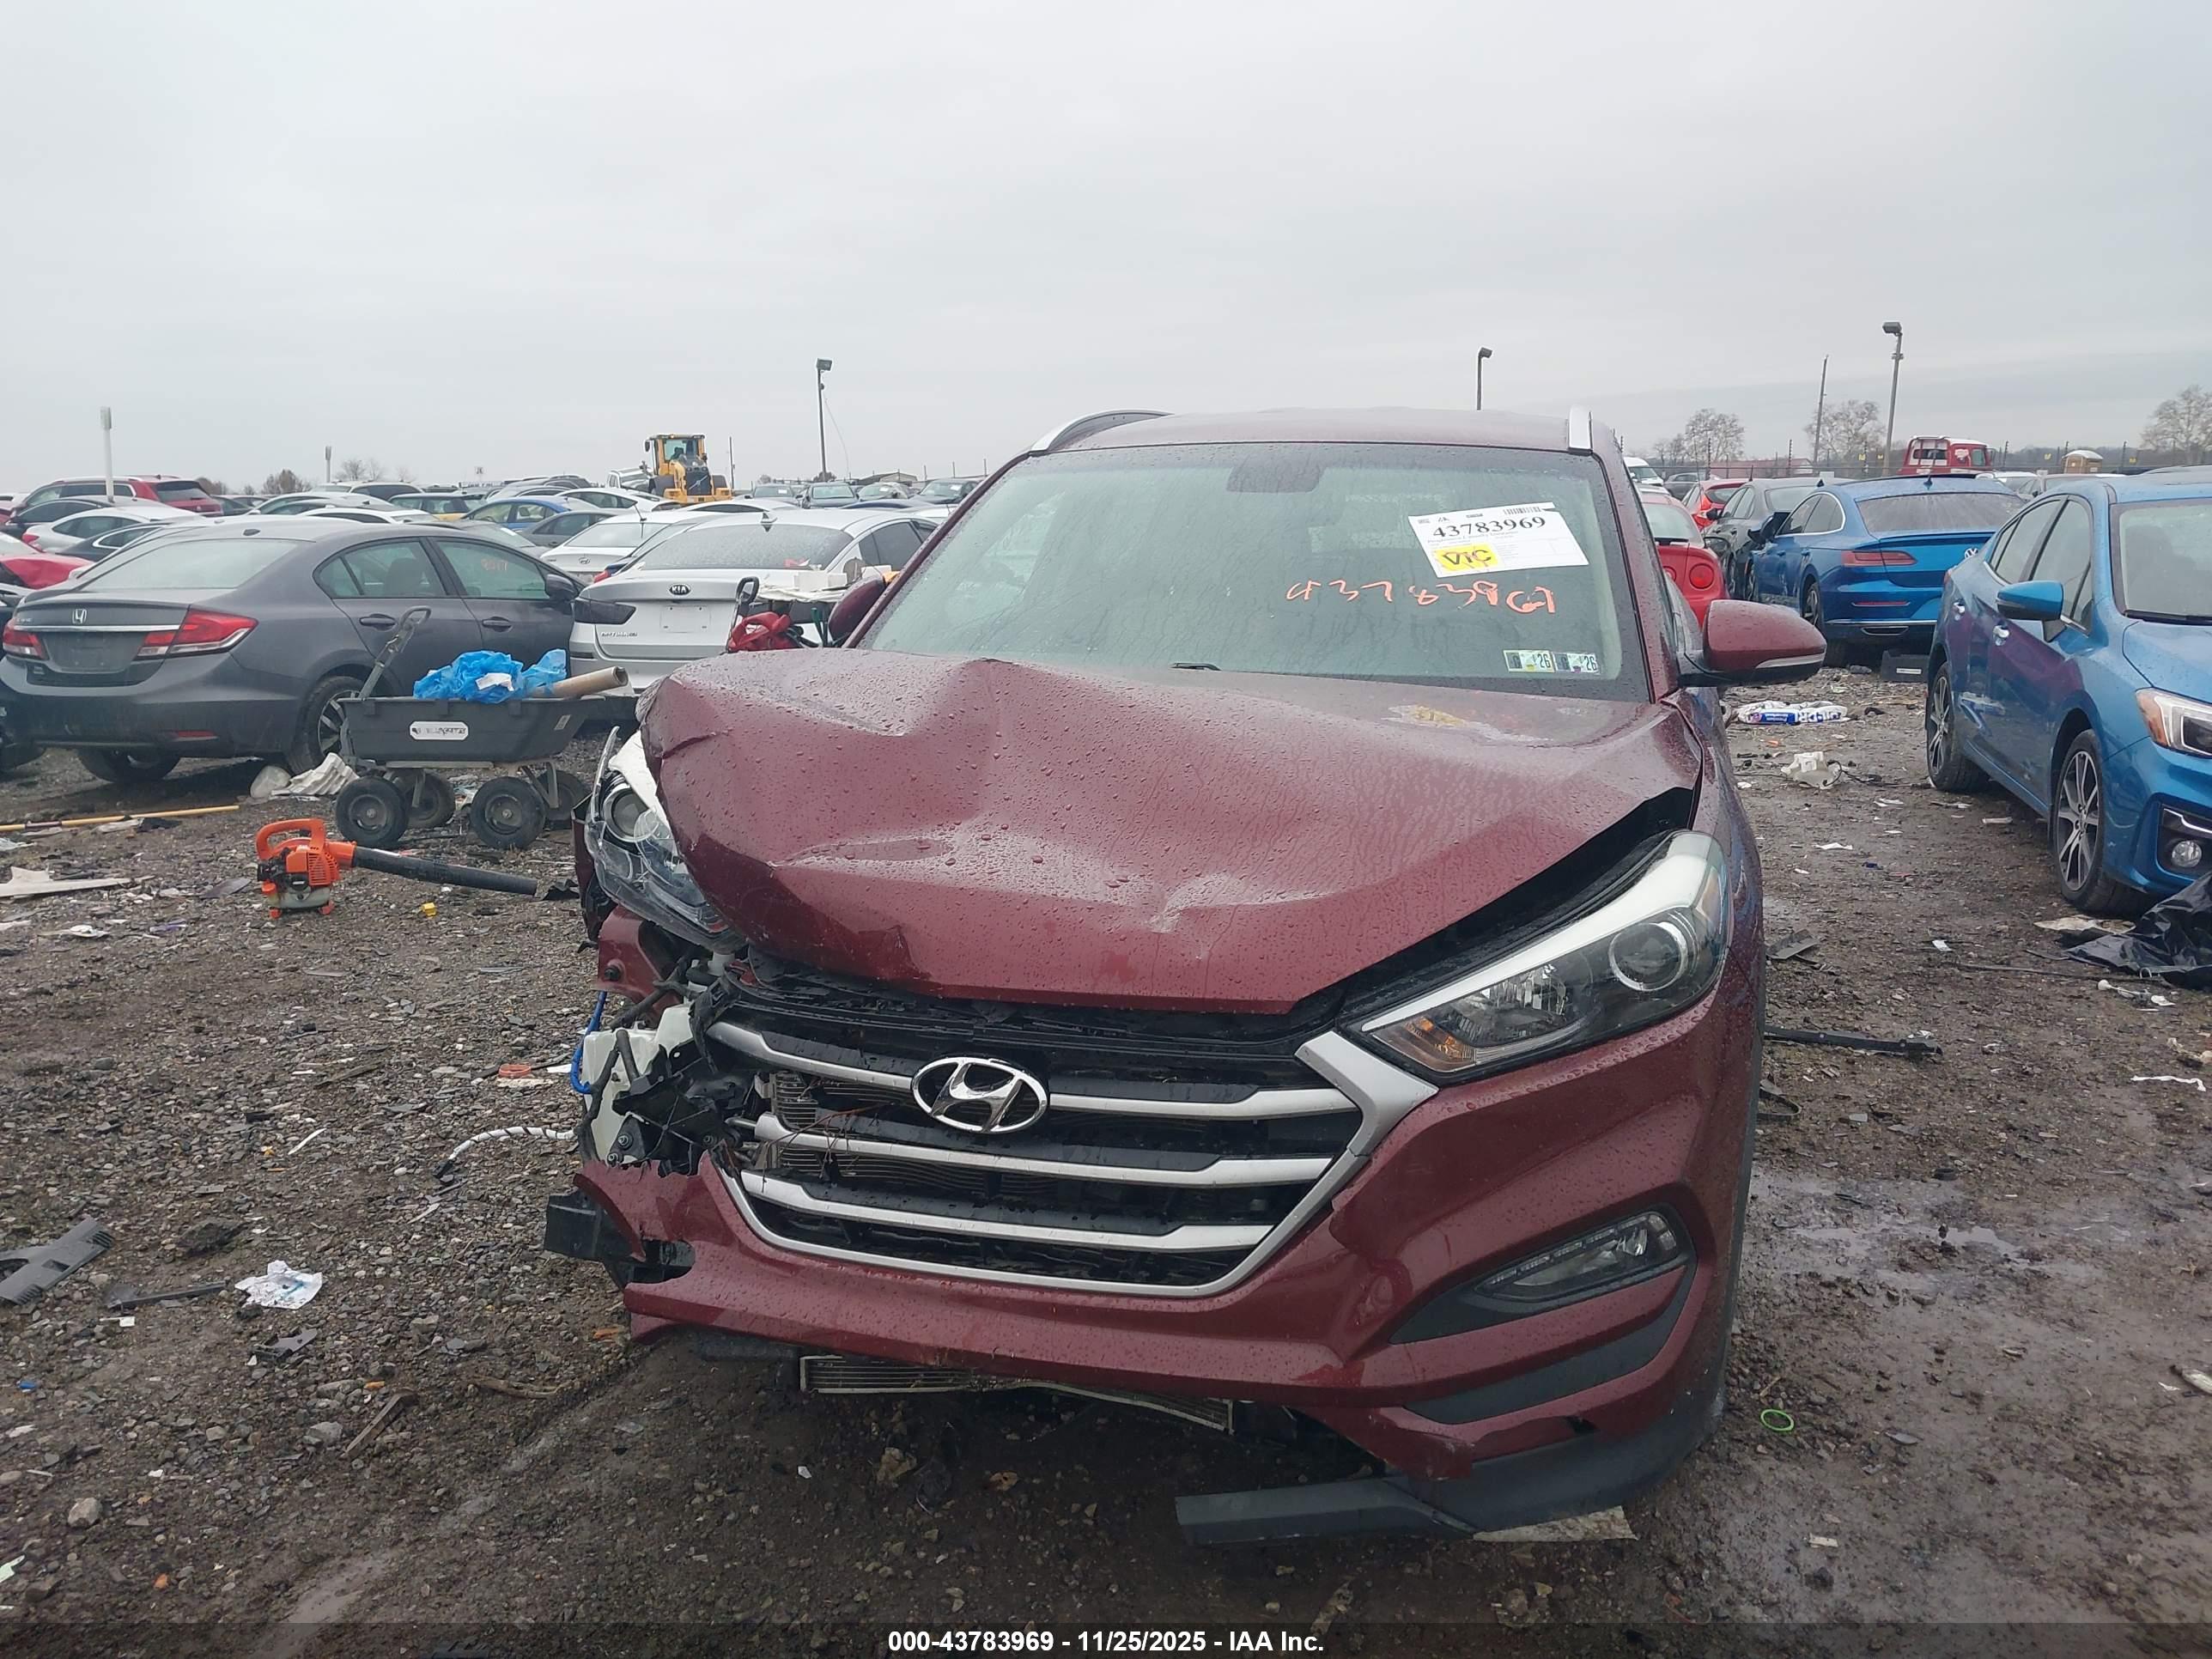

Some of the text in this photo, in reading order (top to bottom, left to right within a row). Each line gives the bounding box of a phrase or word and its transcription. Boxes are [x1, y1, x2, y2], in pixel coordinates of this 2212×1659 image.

[1432, 516, 1547, 538] 43783969
[671, 585, 687, 593] KIA
[1537, 653, 1550, 668] 26
[1584, 655, 1597, 671] 26
